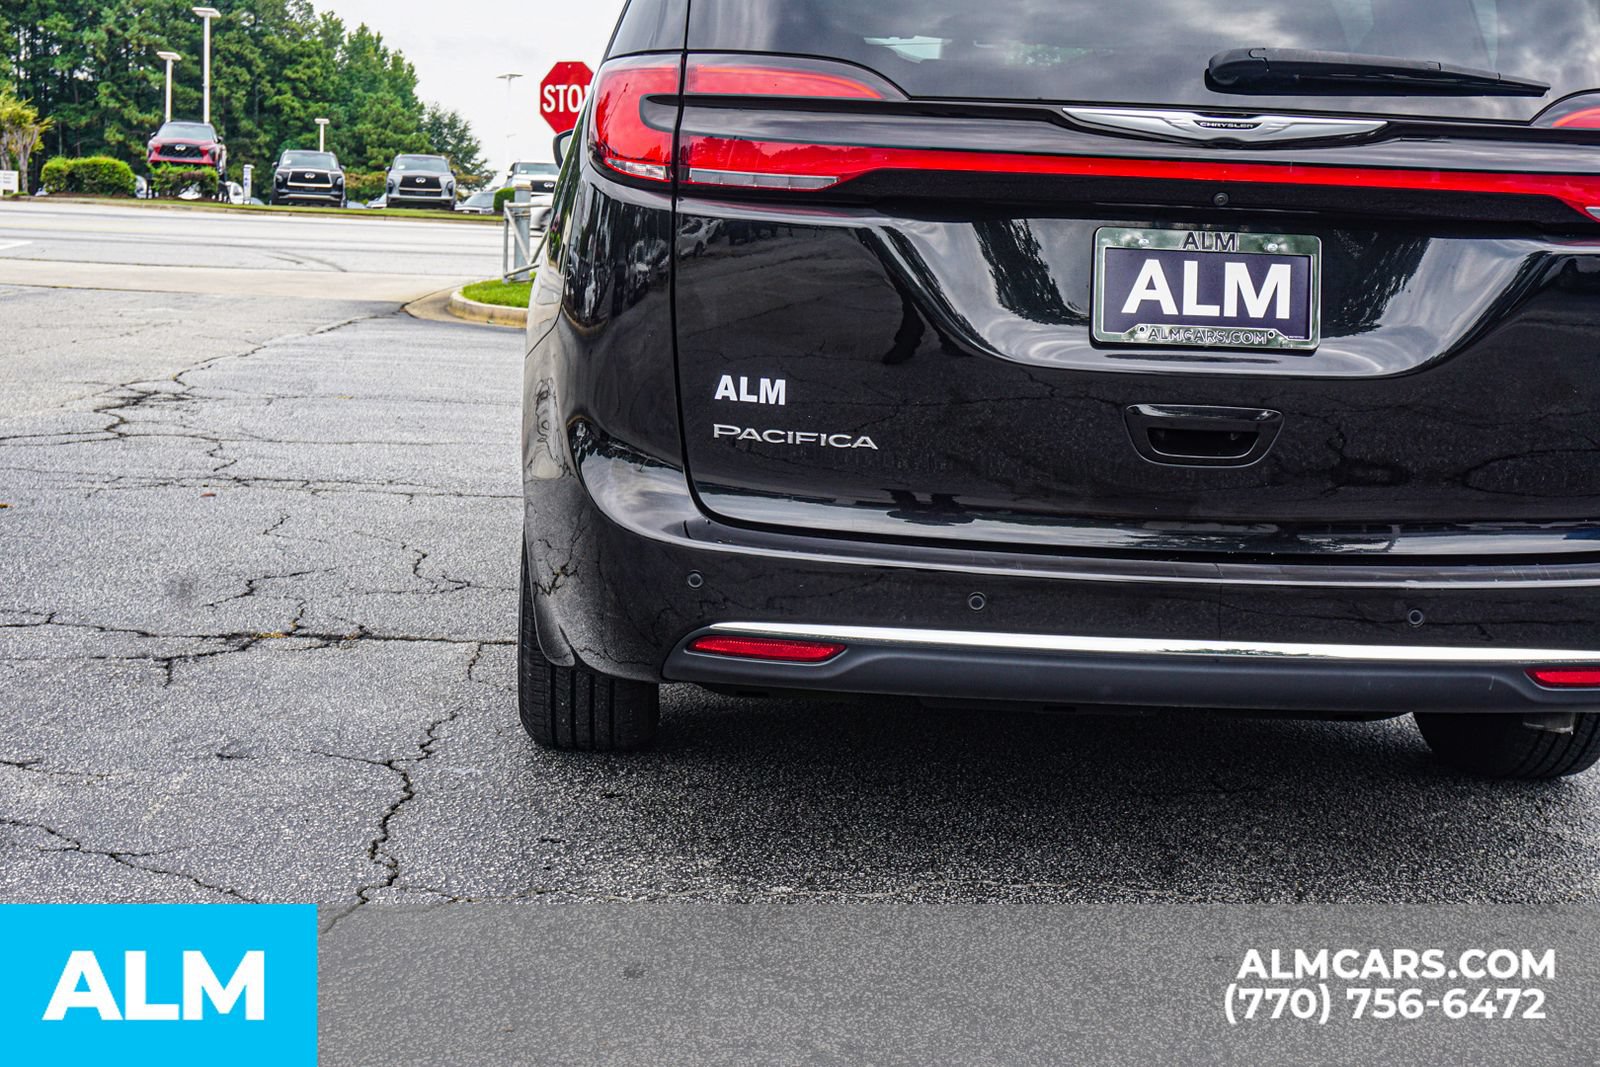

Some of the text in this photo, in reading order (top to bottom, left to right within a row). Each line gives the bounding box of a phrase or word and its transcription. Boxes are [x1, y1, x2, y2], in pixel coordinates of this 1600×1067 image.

[1182, 231, 1237, 251] ALM
[1121, 258, 1292, 320] ALM
[1149, 327, 1267, 345] ALMCARS.COM
[714, 374, 786, 406] ALM
[713, 423, 879, 450] PACIFICA
